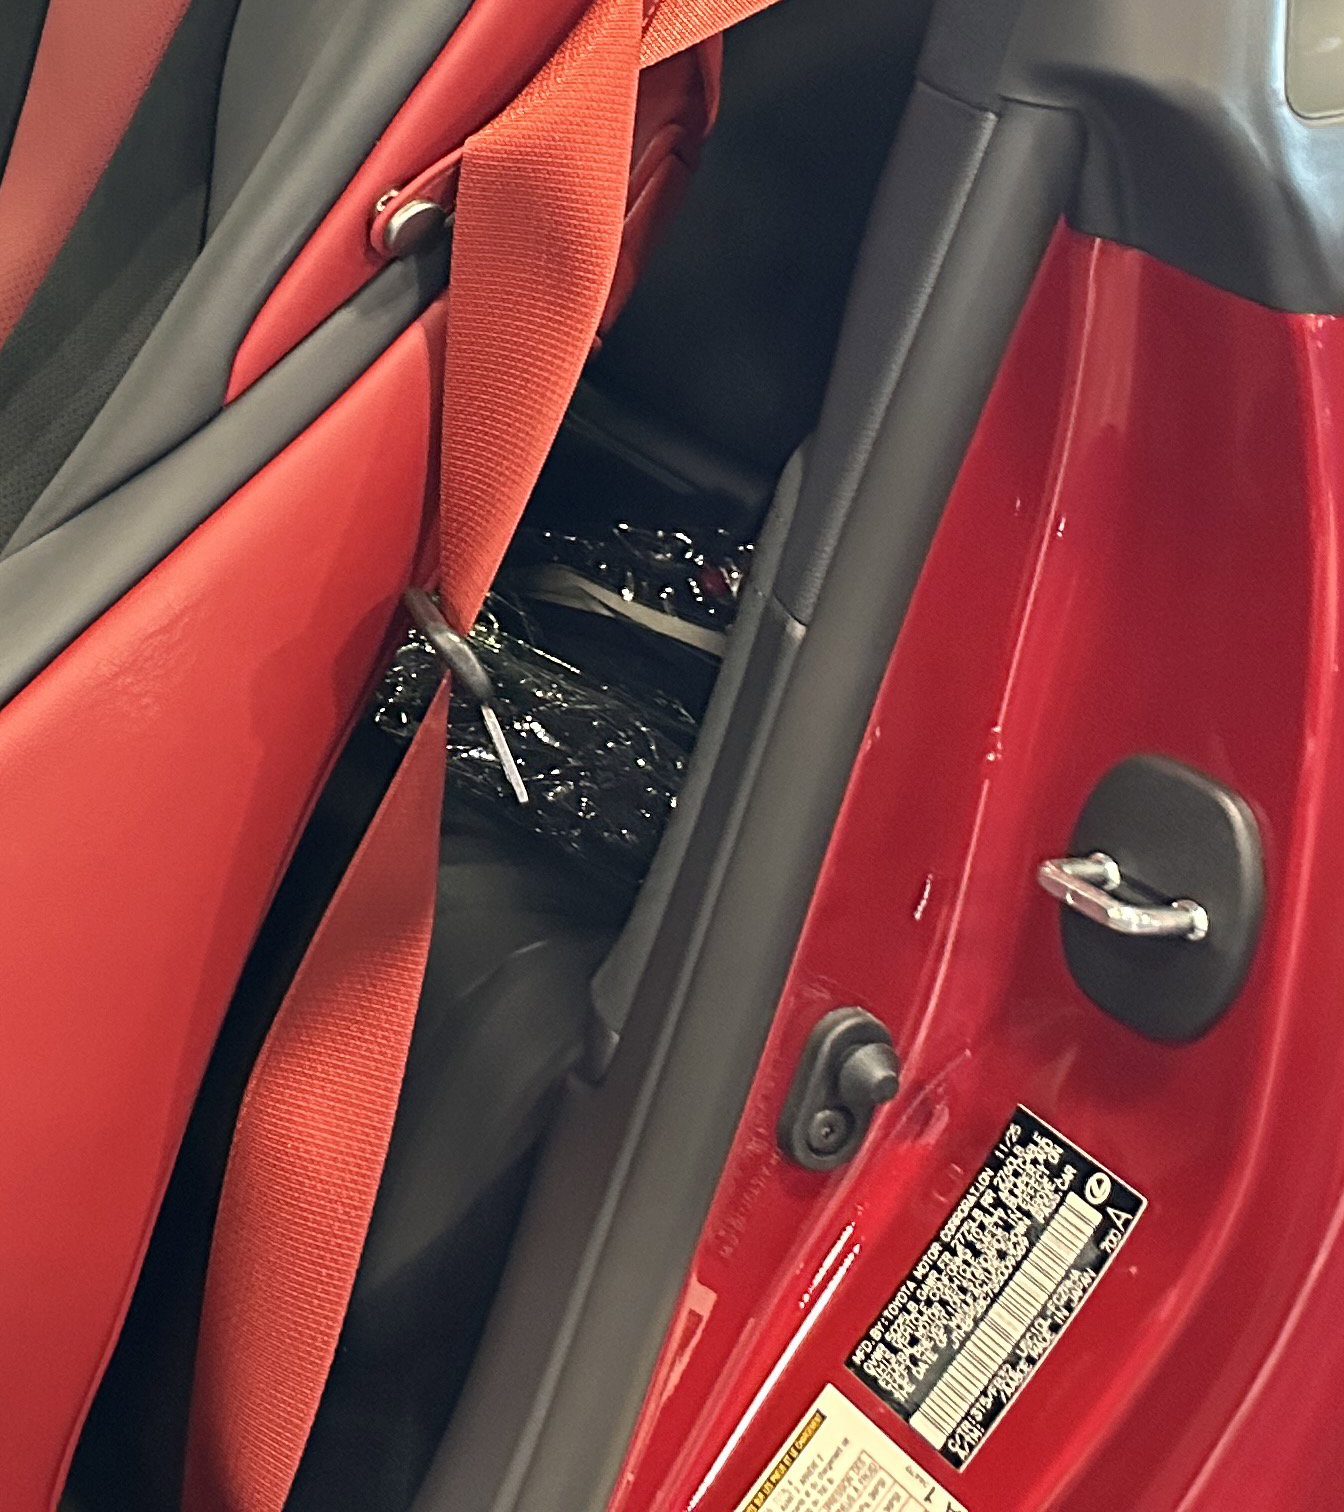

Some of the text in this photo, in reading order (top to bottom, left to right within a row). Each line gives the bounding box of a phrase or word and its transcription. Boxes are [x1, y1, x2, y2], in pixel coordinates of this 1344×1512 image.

[911, 1239, 943, 1281] MOTOR
[938, 1164, 995, 1244] CORPORATION
[992, 1120, 1023, 1160] 11/25
[1106, 1206, 1133, 1231] A
